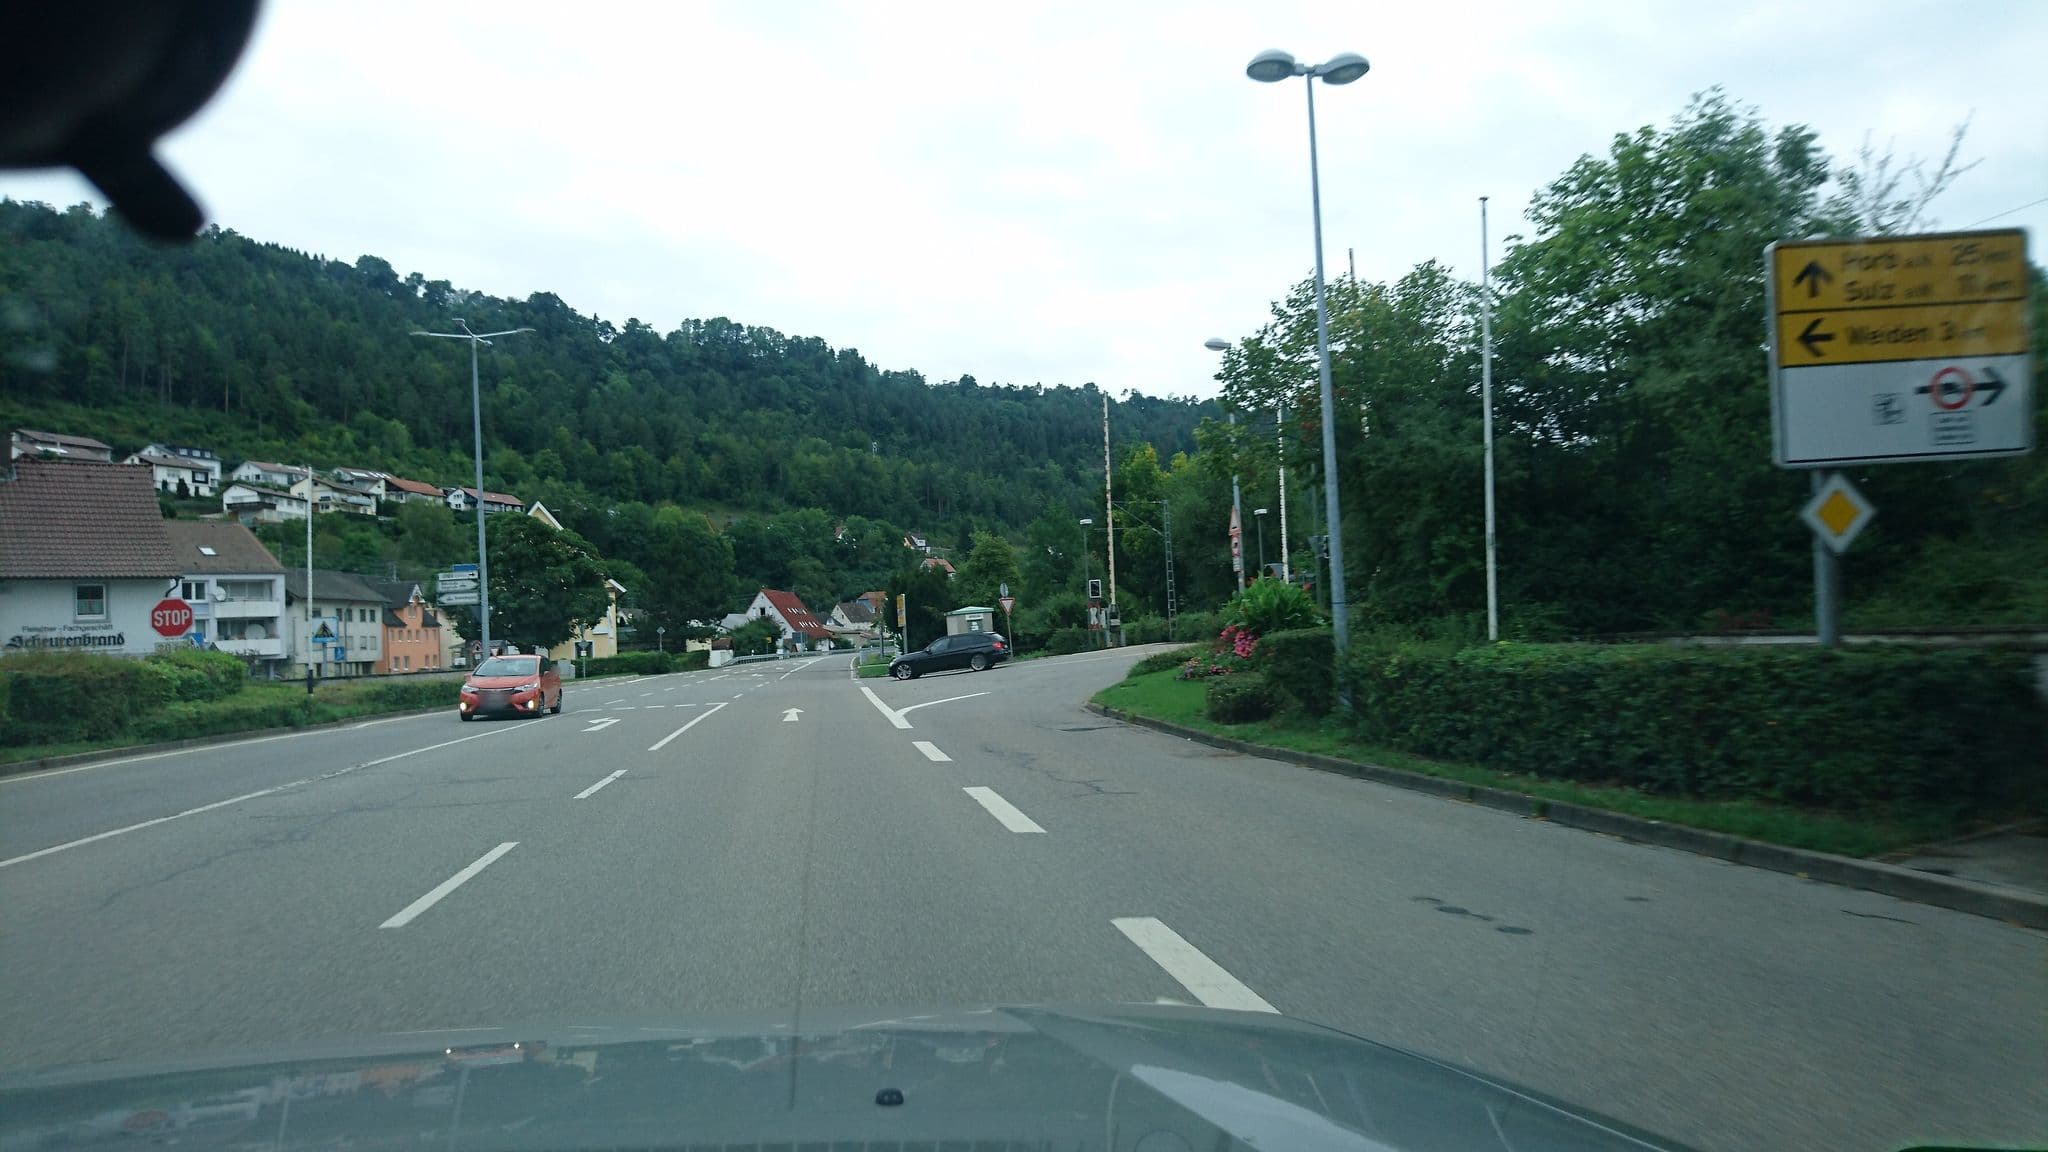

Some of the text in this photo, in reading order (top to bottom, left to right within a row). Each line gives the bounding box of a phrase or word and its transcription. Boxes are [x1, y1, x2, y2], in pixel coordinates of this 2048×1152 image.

[1845, 279, 1897, 302] Sulz
[153, 609, 191, 627] STOP
[7, 632, 125, 648] Scheurenbrand
